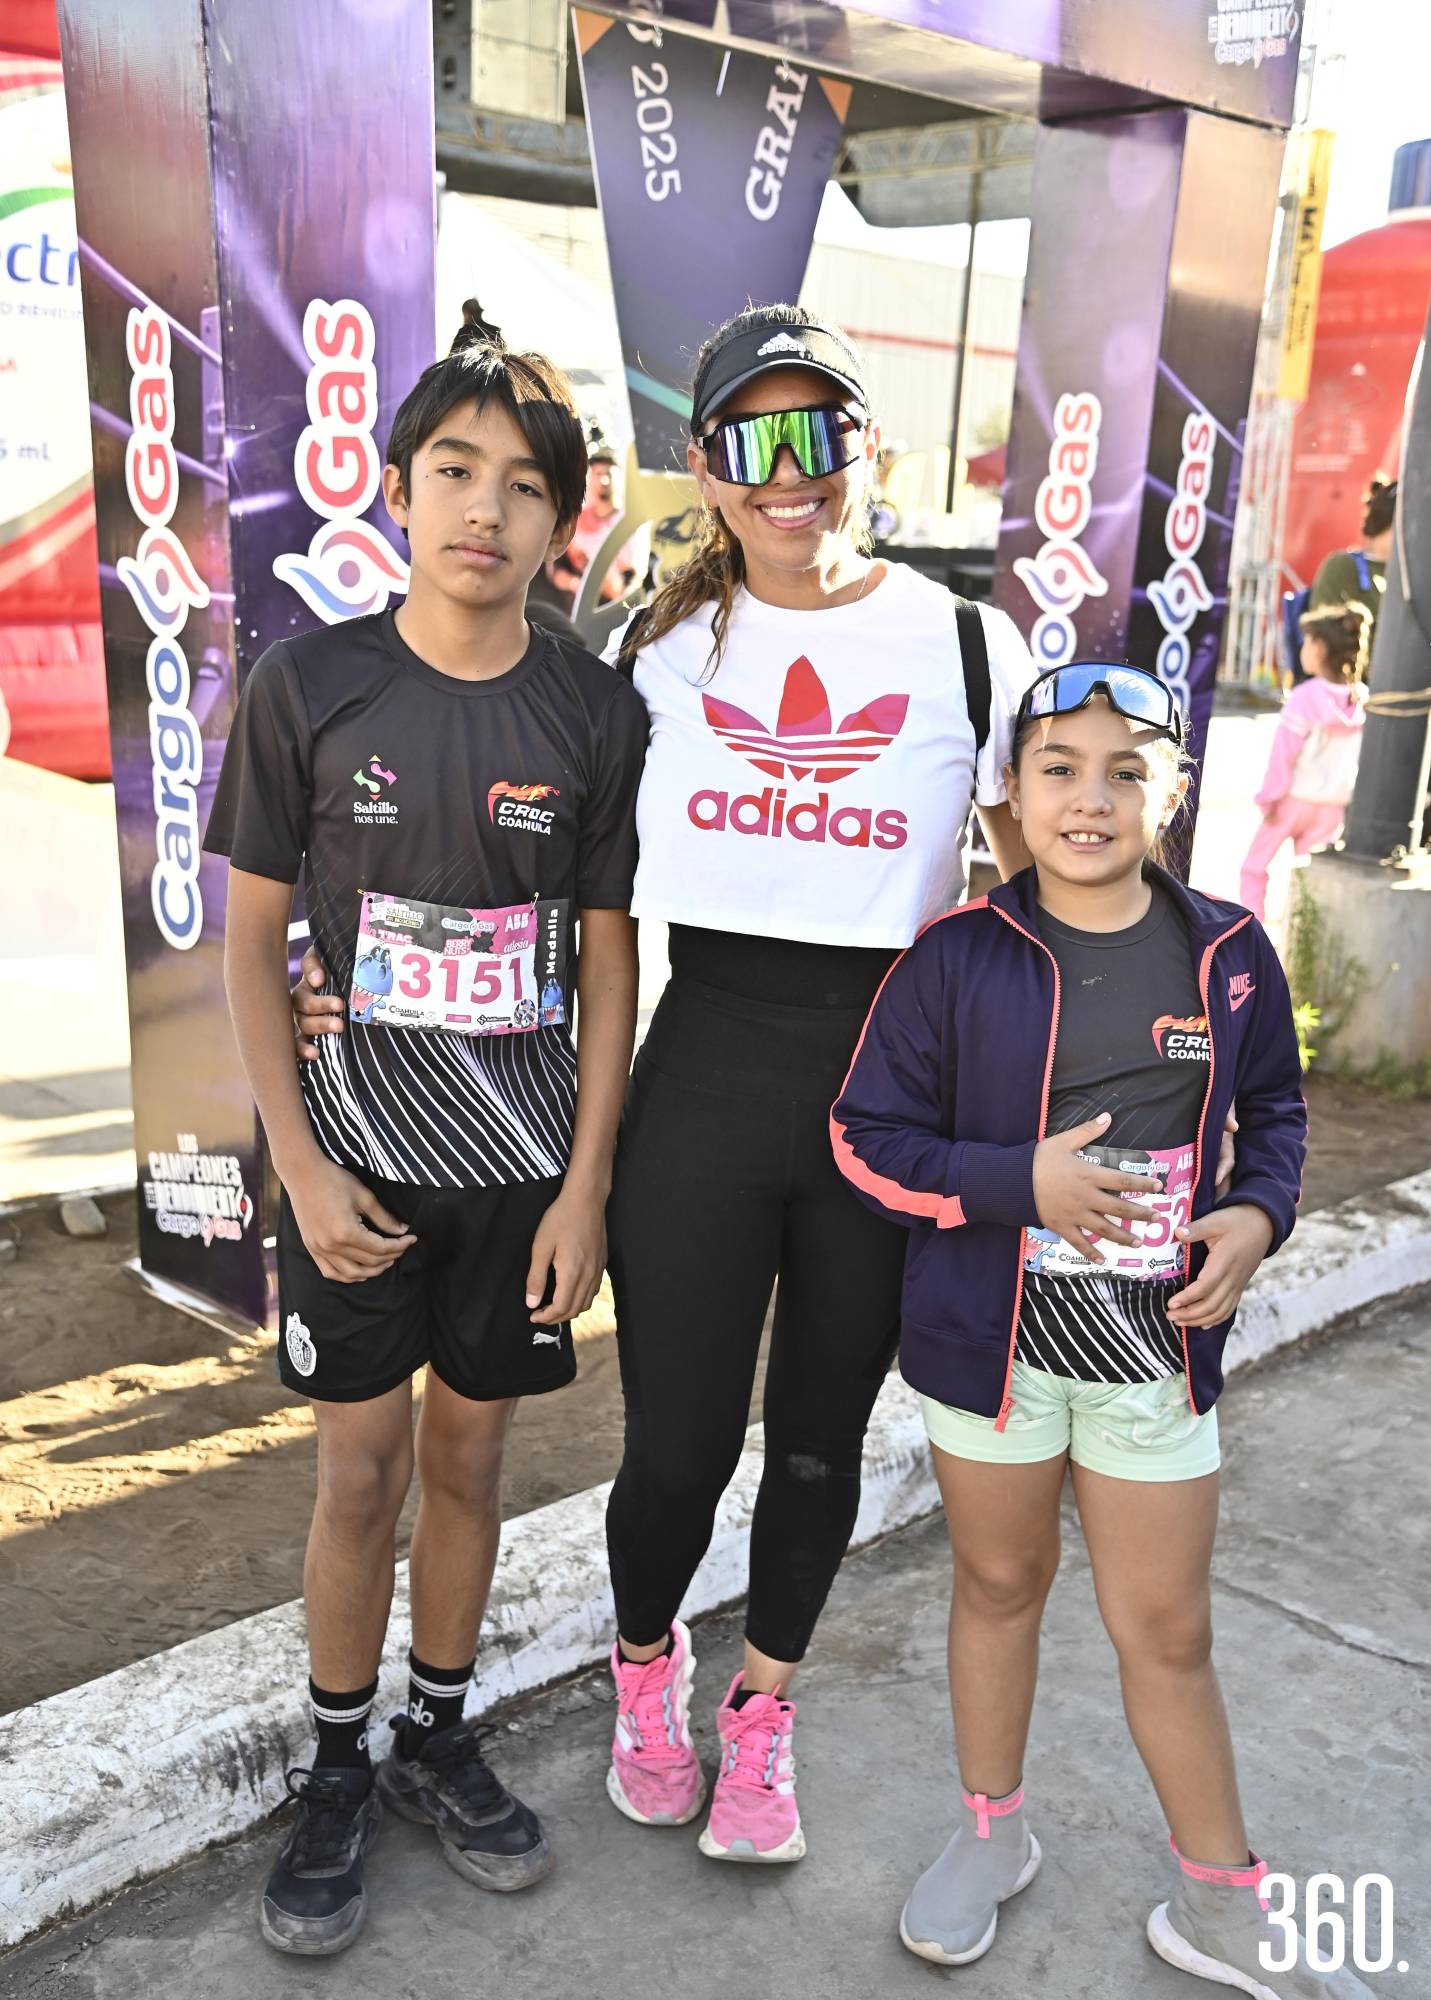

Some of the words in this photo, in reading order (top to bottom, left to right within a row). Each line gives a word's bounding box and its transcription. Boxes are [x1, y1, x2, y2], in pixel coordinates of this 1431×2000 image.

[631, 62, 682, 202] 2025
[132, 316, 173, 517] Gas
[305, 311, 371, 508] Gas
[1043, 398, 1093, 531] Gas
[1171, 422, 1210, 551] Gas
[153, 646, 196, 938] Cargo
[353, 801, 398, 814] Saltillo
[354, 816, 373, 824] nos
[375, 815, 399, 824] une.
[687, 787, 909, 850] adidas
[497, 815, 551, 836] COAHUILA
[505, 912, 529, 932] ABB
[546, 908, 559, 974] Medalla
[398, 953, 523, 1005] 3151
[1229, 972, 1251, 996] NIKE
[148, 1152, 243, 1188] CAMPEONES
